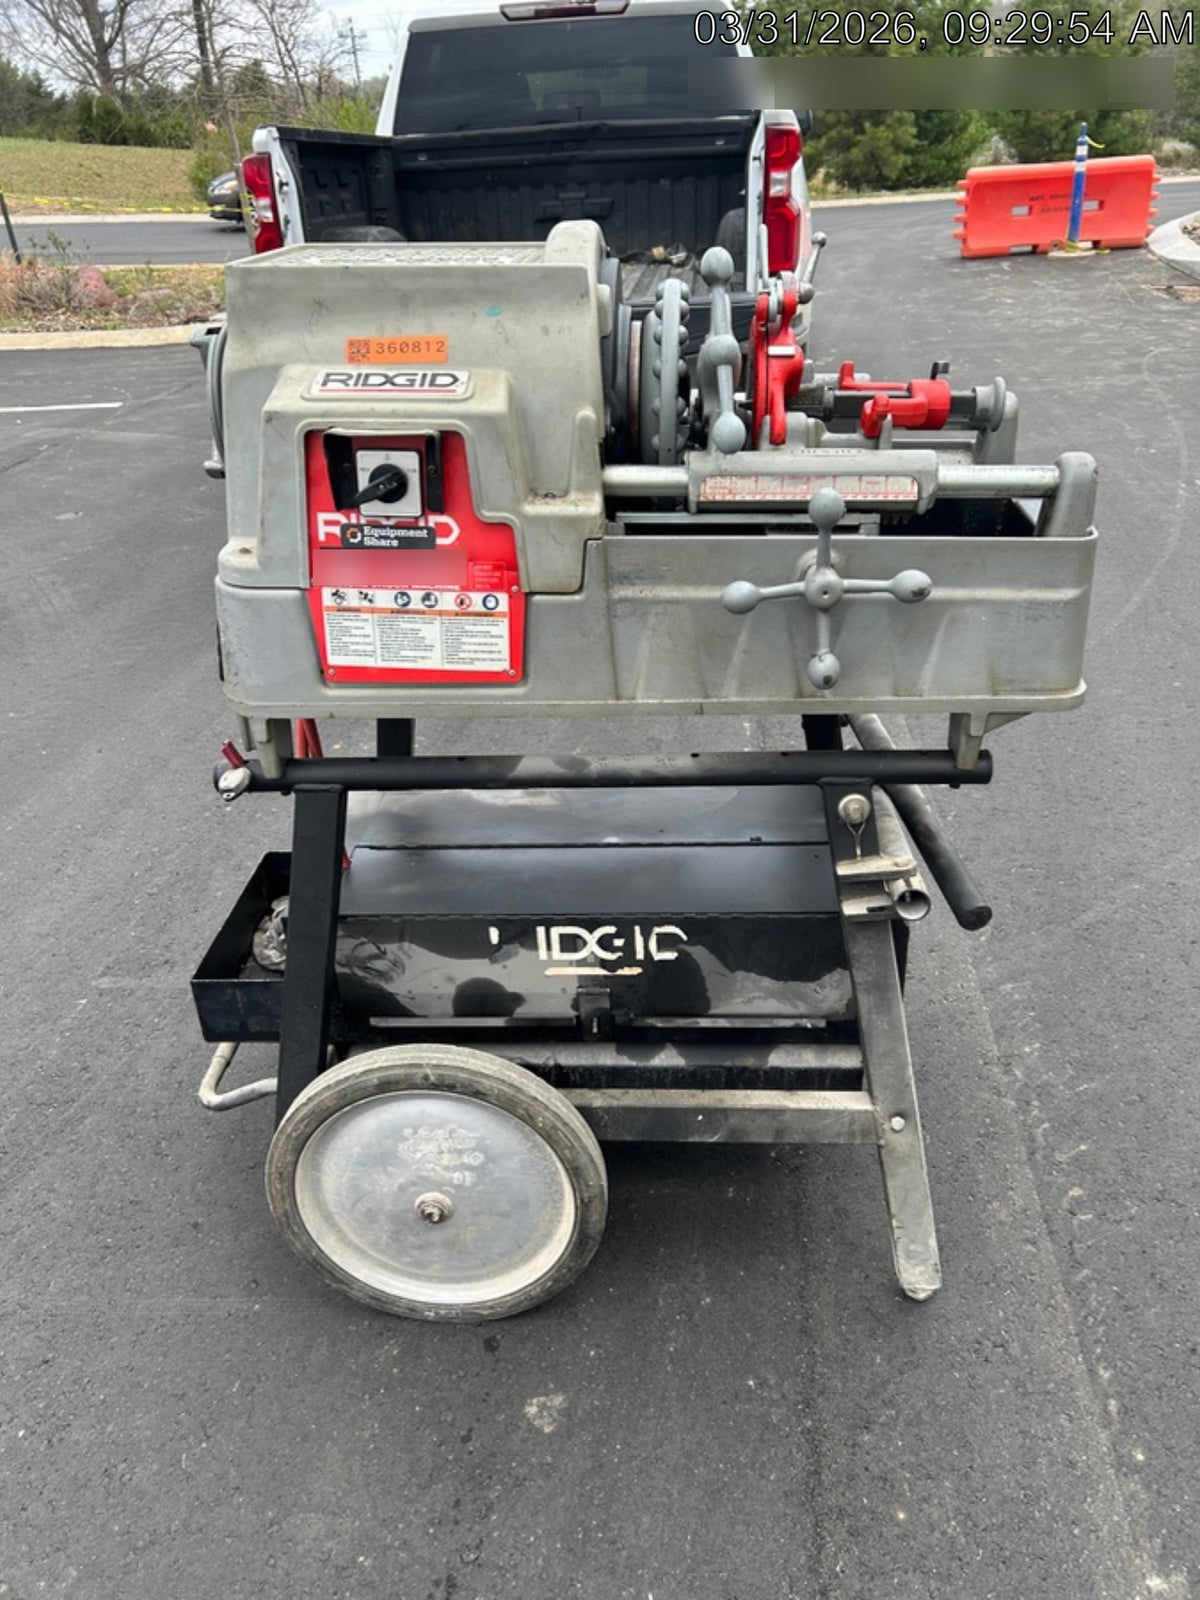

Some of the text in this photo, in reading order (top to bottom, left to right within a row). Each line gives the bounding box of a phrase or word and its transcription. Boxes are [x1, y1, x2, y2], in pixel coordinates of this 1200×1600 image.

[375, 340, 446, 355] 360812
[320, 372, 460, 388] RIDGID
[363, 526, 429, 538] Equipment
[363, 536, 399, 547] Share
[488, 925, 688, 961] IDGID
